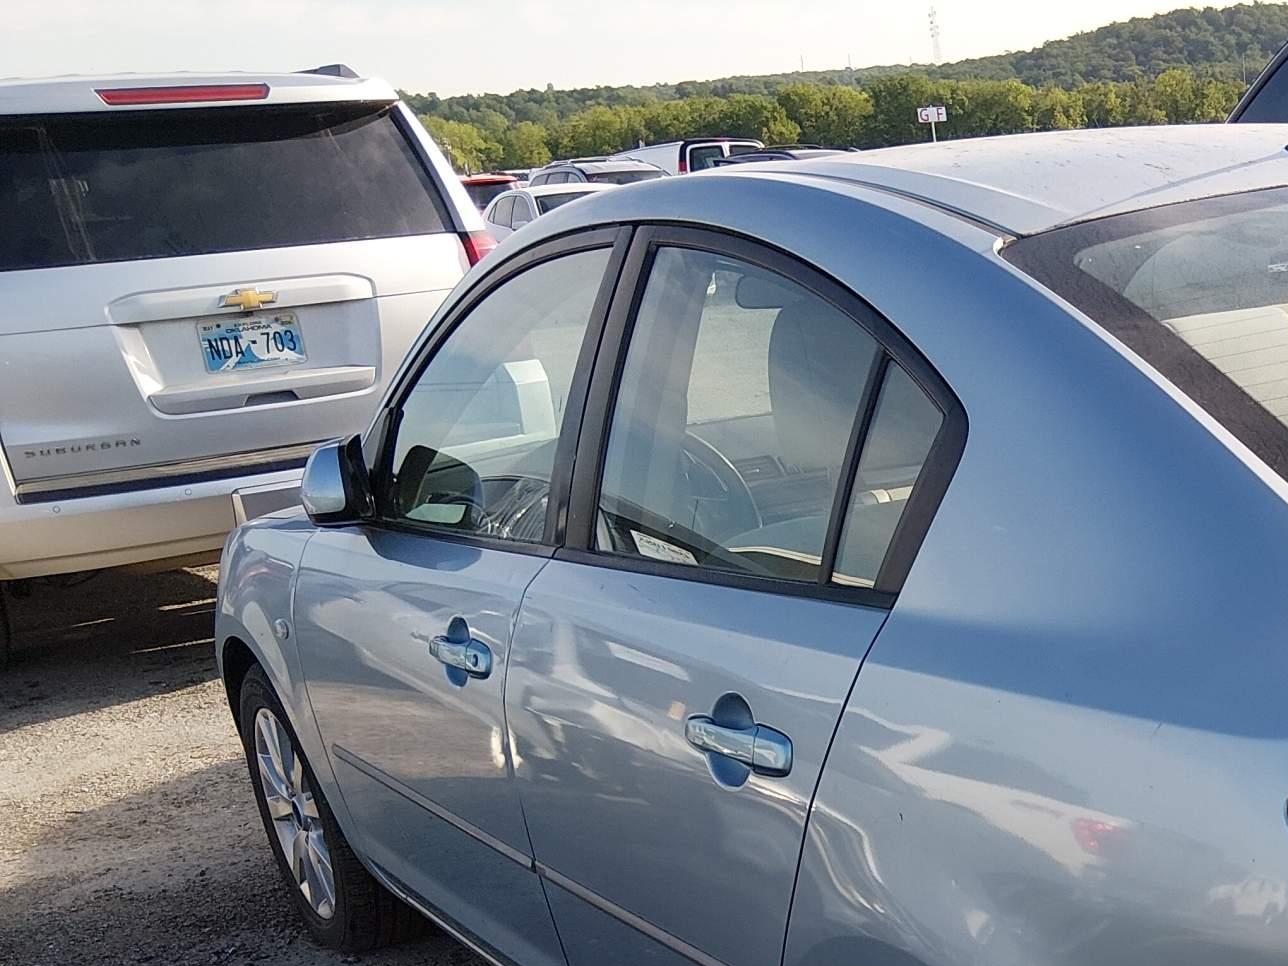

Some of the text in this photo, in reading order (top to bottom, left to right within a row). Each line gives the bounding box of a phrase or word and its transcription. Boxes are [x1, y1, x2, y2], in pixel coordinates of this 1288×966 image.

[919, 107, 944, 122] G F
[225, 324, 273, 334] OKLAHOMA
[24, 438, 141, 458] SUBURBAN
